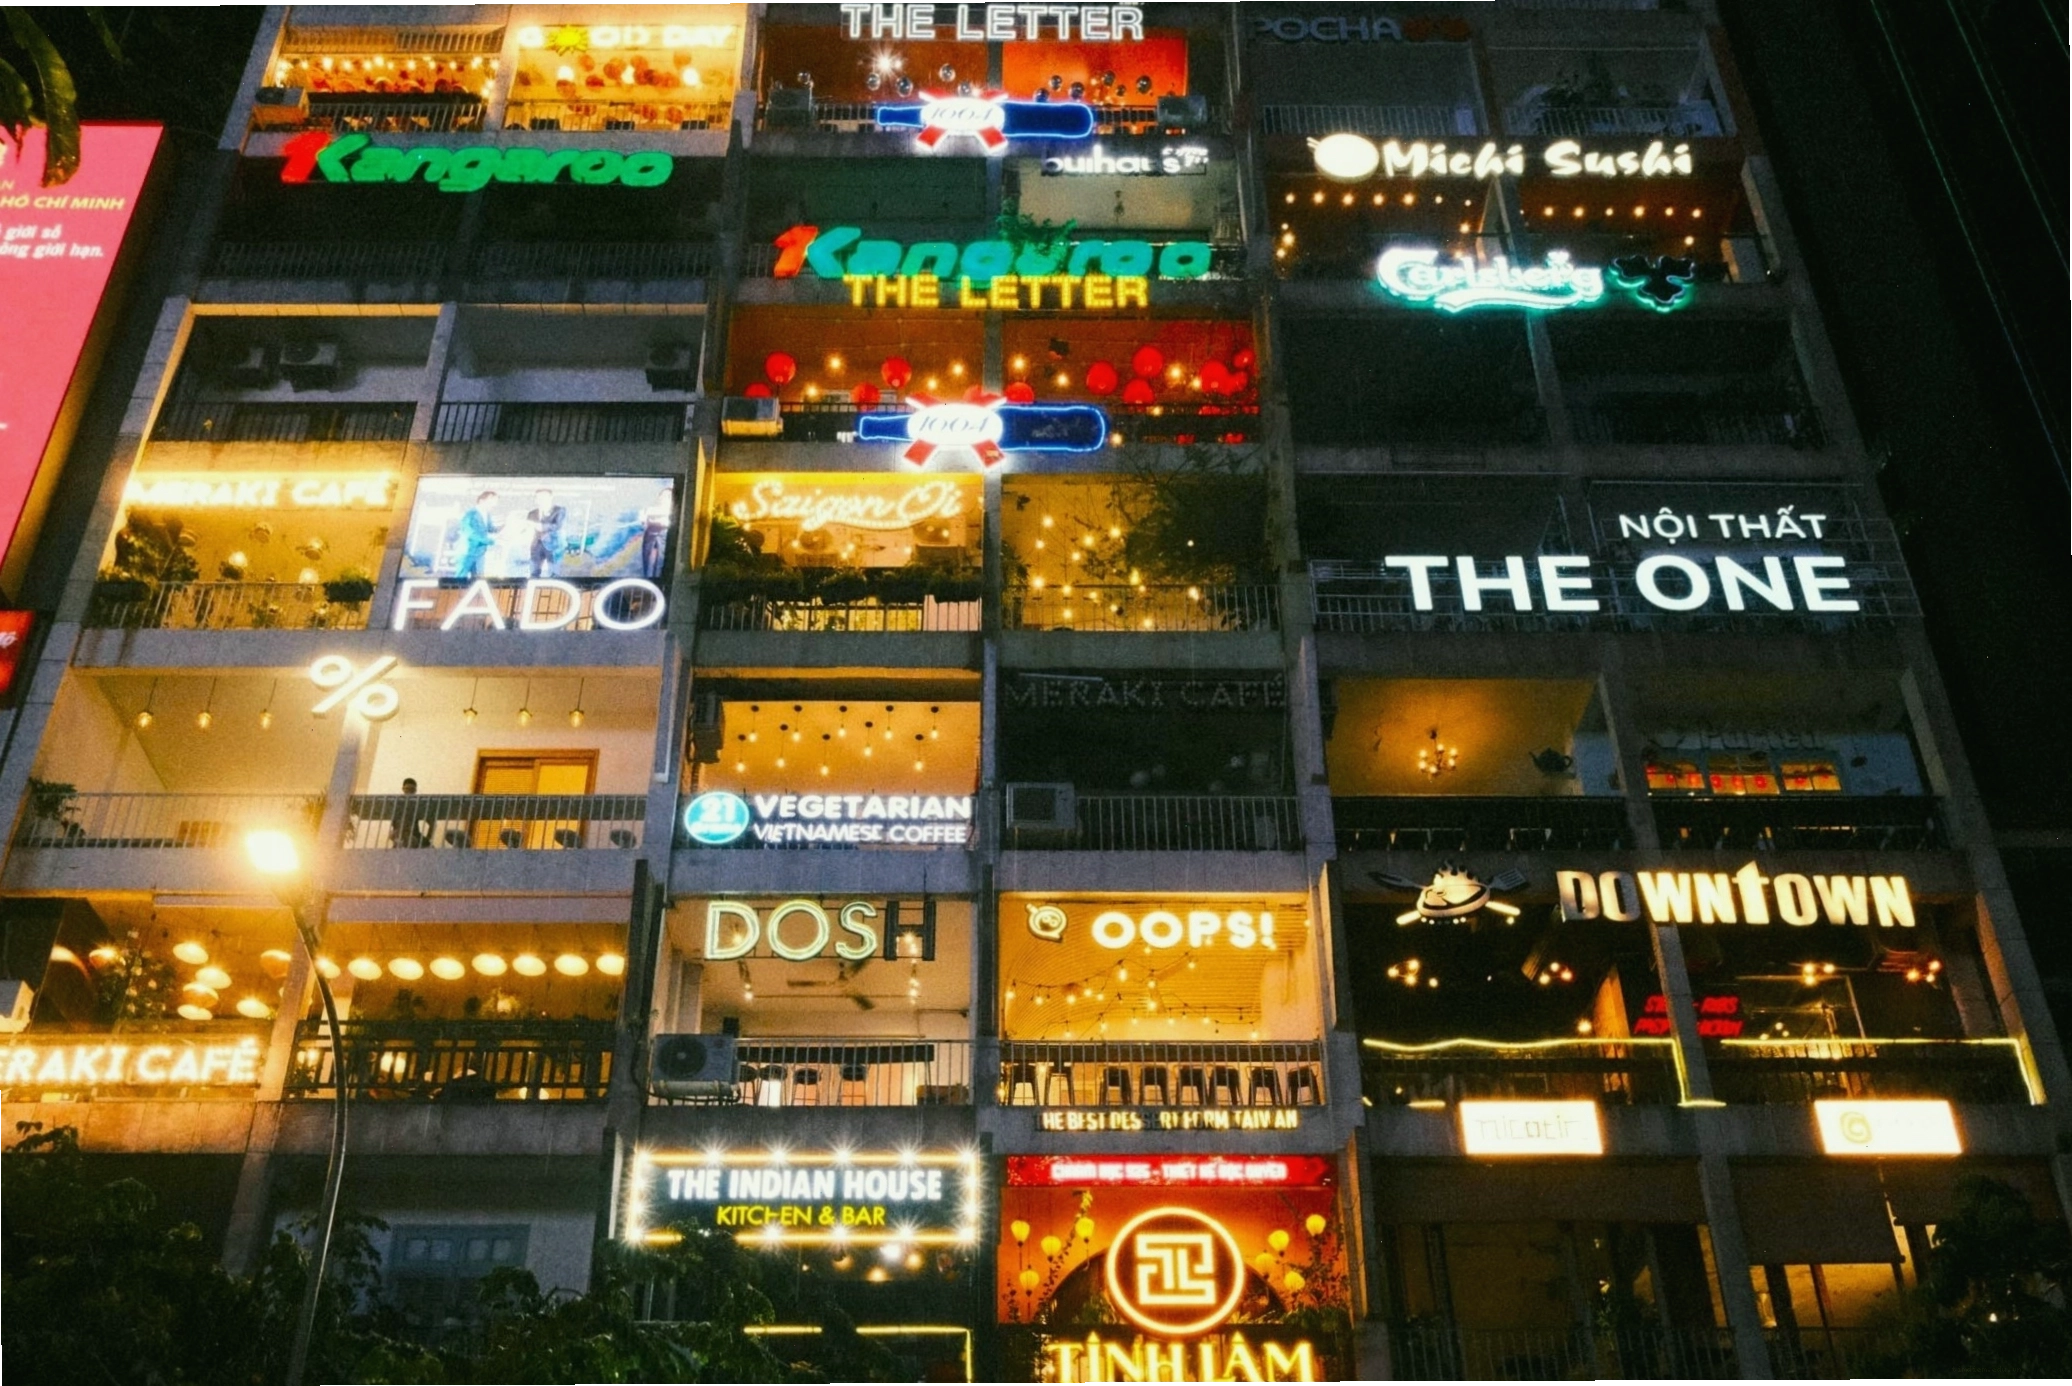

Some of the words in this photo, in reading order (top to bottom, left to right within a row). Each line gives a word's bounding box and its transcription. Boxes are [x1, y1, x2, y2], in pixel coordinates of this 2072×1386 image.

[840, 3, 936, 39] THE
[956, 4, 1145, 41] LETTER
[1382, 140, 1525, 178] Michi
[1544, 140, 1693, 177] Sushi
[70, 197, 125, 210] MINH
[843, 274, 939, 307] THE
[958, 274, 1149, 308] LETTER
[732, 480, 895, 531] Saigon
[1619, 507, 1698, 544] NỘI
[1708, 504, 1826, 538] THẤT
[1385, 555, 1600, 612] THE
[1635, 554, 1860, 612] ONE
[393, 578, 666, 631] FADO
[1004, 680, 1165, 707] MERAKI
[753, 795, 972, 819] VEGETARIAN
[752, 823, 883, 843] VIETNAMESE
[889, 824, 968, 843] COFFEE
[704, 900, 937, 961] DOSH
[1091, 911, 1275, 949] OOPS!
[0, 1045, 129, 1083] RAKI
[136, 1037, 259, 1083] CAFÉ
[1067, 1111, 1105, 1130] BEST
[667, 1169, 721, 1200] THE
[728, 1169, 835, 1200] INDIAN
[844, 1169, 942, 1200] HOUSE
[716, 1206, 812, 1226] KITCHEN
[818, 1206, 836, 1226] &
[841, 1206, 886, 1226] BAR
